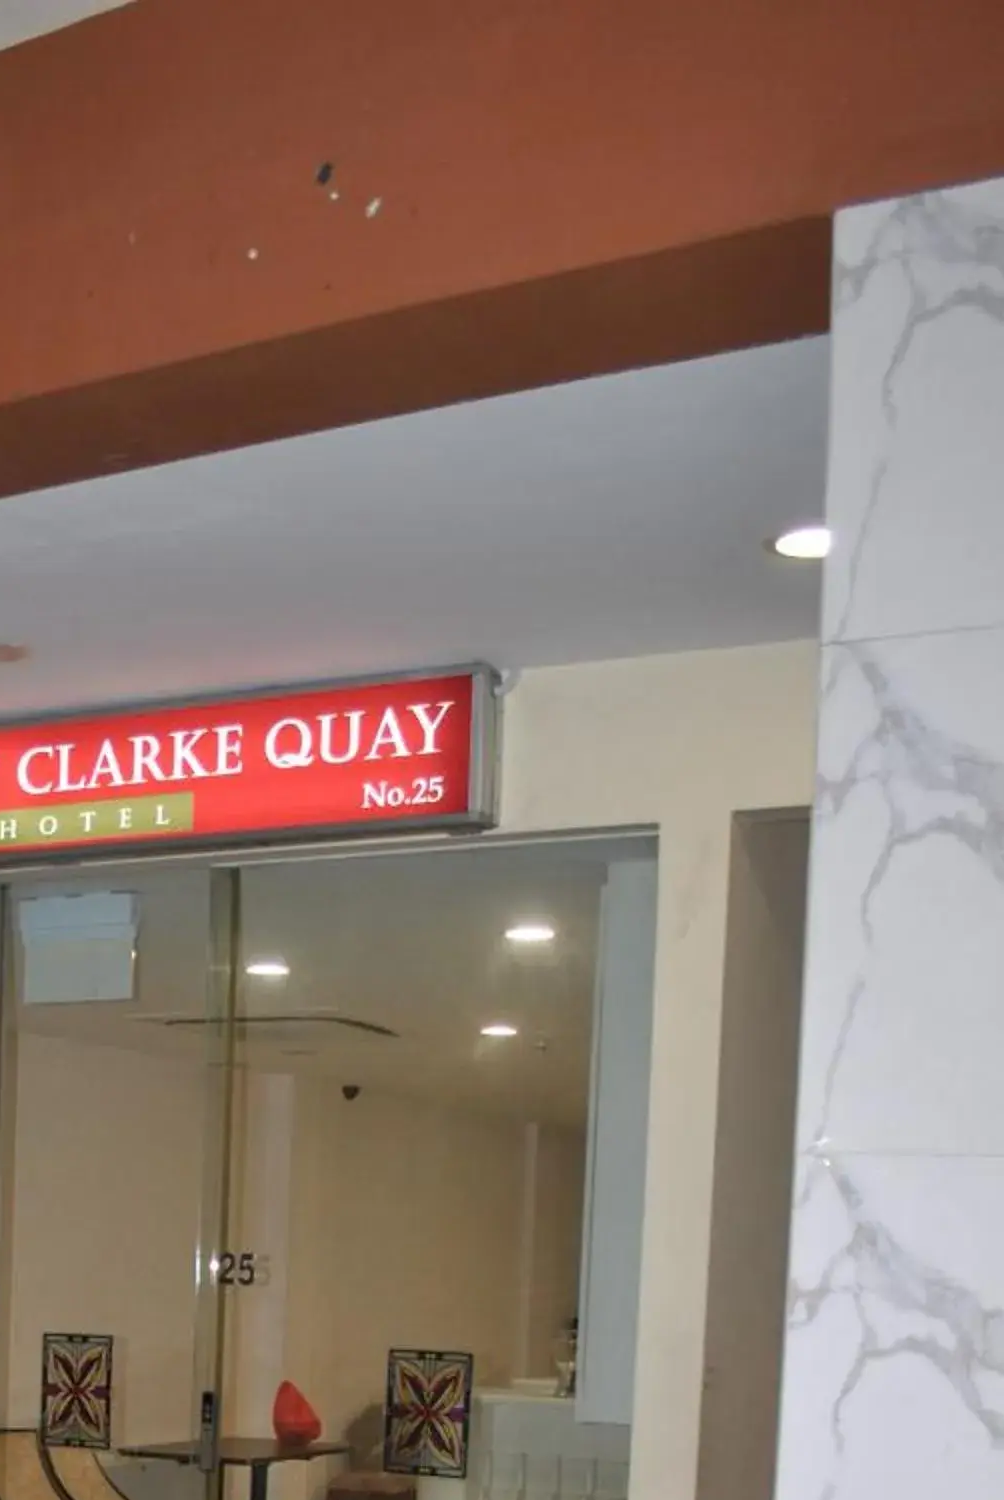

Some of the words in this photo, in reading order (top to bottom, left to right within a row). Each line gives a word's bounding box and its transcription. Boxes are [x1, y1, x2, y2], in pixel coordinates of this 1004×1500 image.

[16, 723, 244, 796] CLARKE
[265, 701, 455, 769] QUAY
[361, 776, 445, 809] No.25
[0, 805, 170, 840] HOTEL
[218, 1253, 255, 1286] 25
